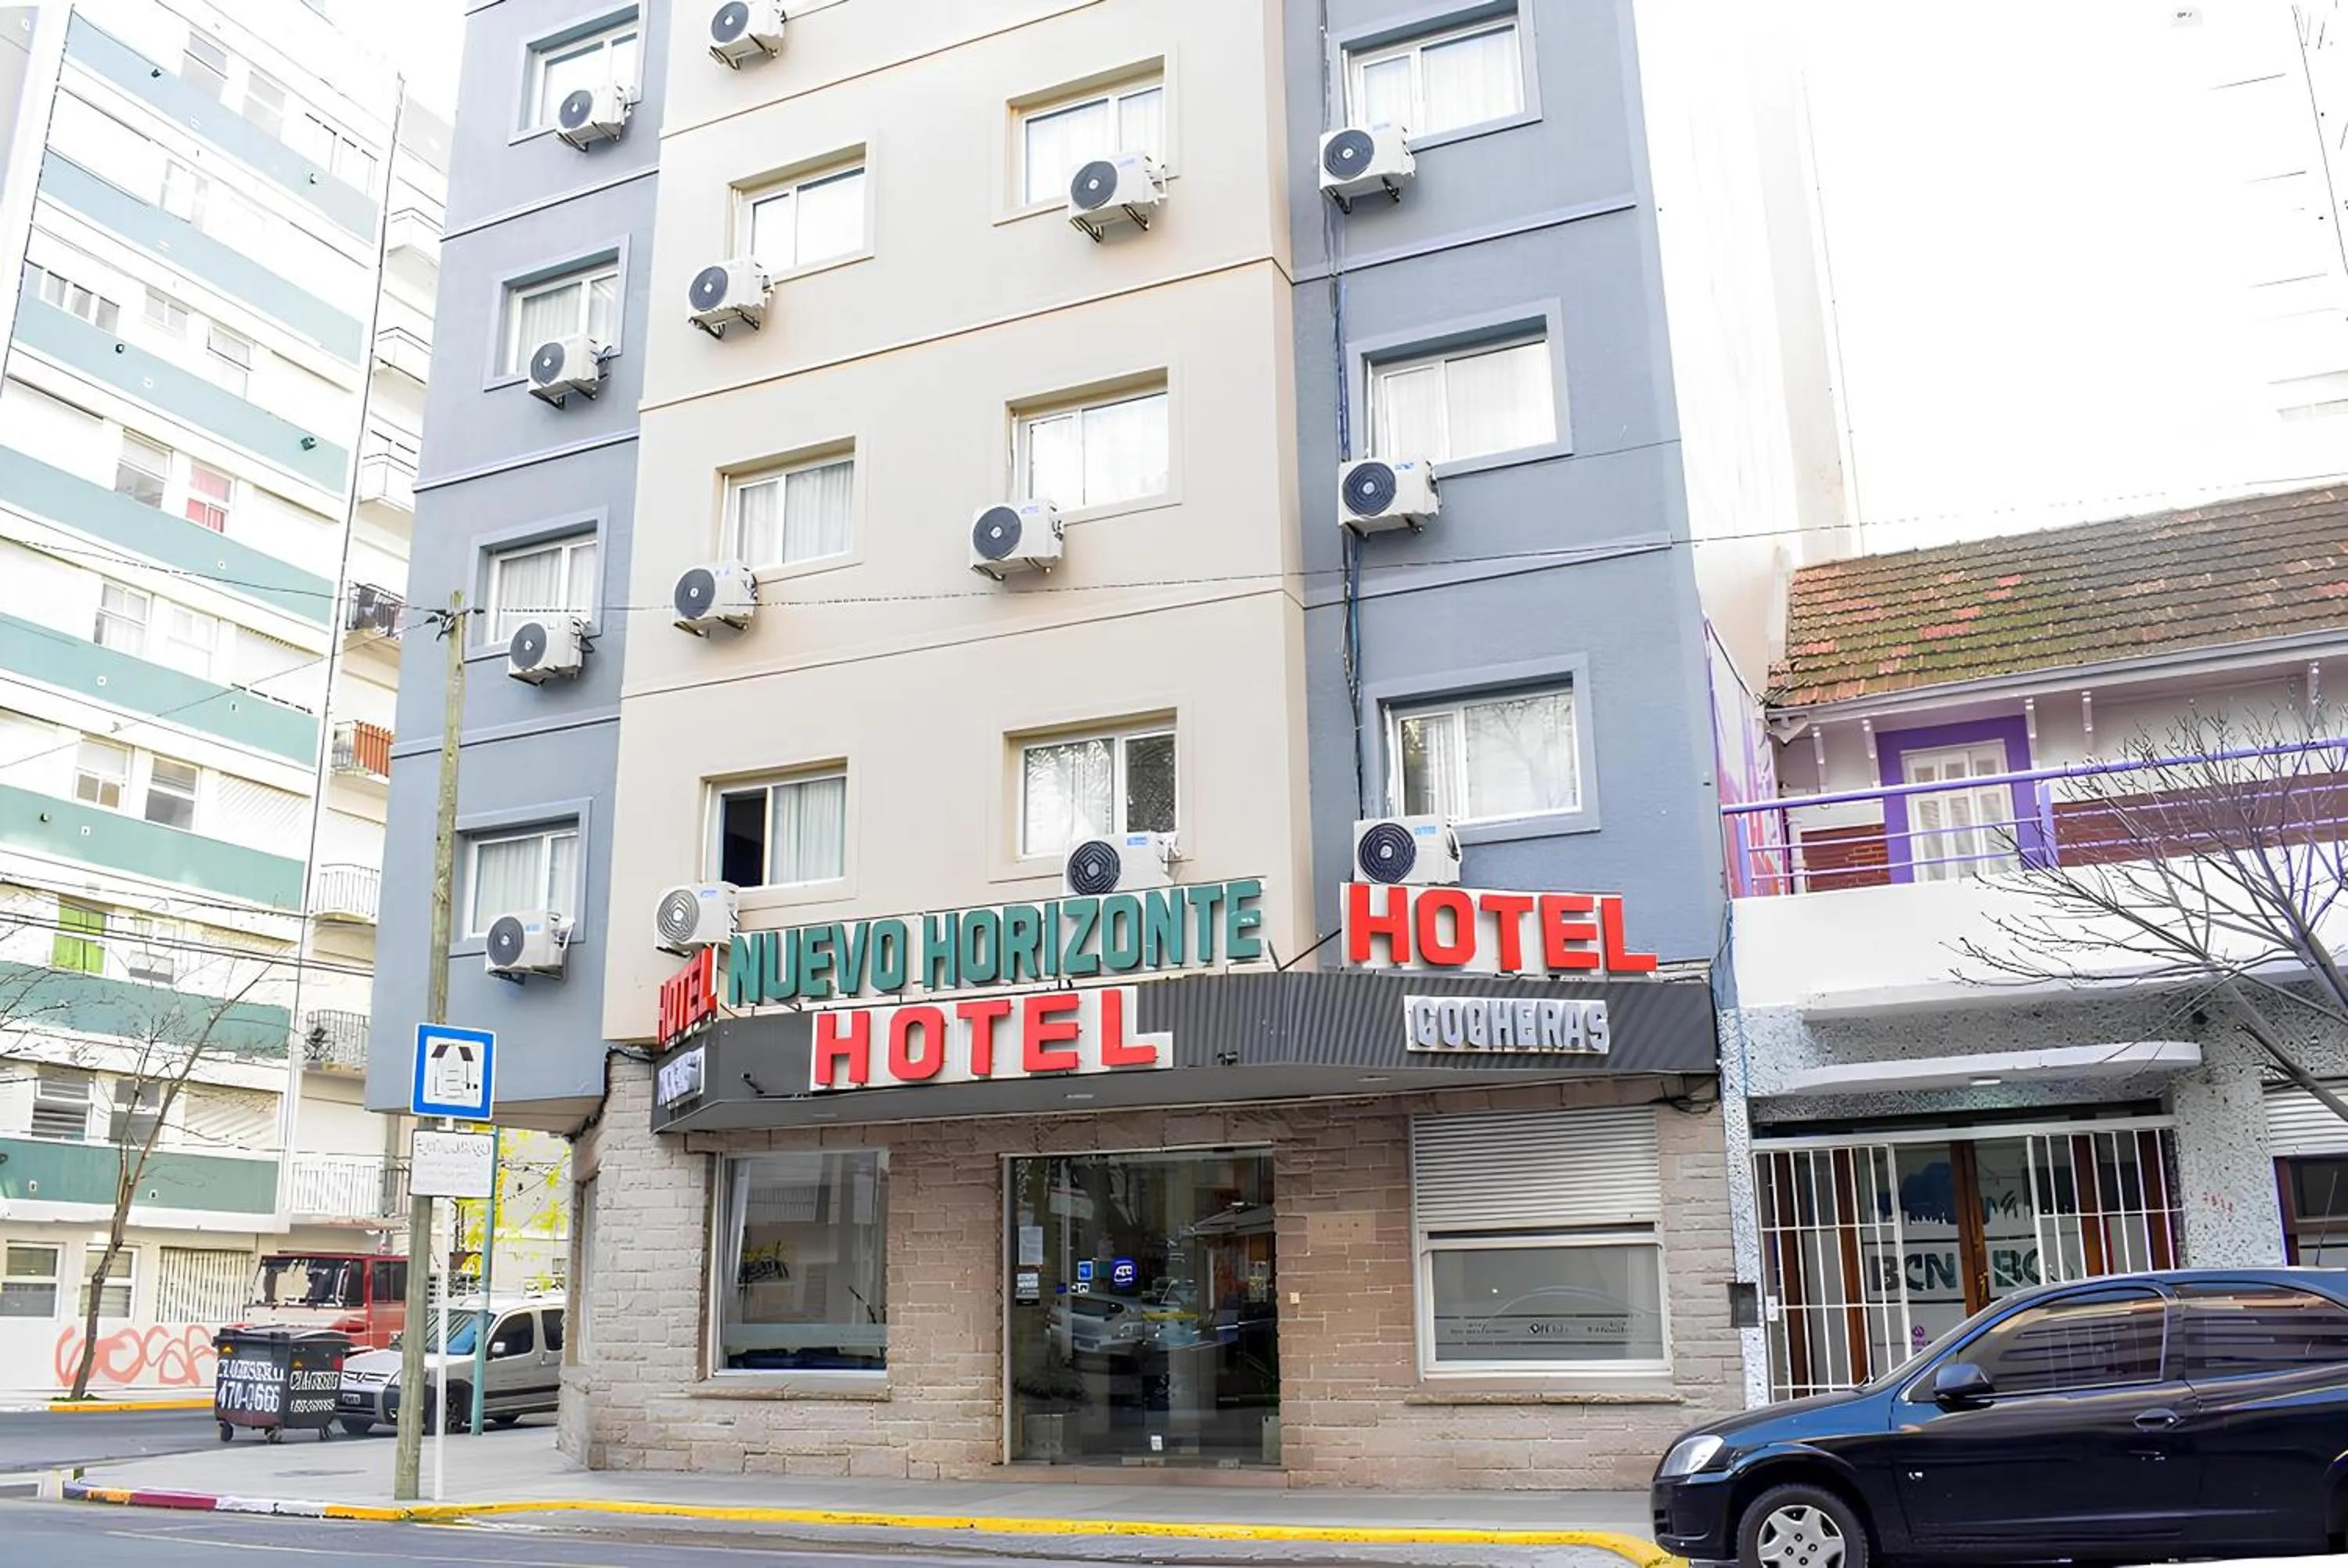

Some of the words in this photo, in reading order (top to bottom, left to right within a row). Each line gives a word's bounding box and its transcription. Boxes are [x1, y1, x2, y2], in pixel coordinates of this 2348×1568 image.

[728, 919, 908, 1005] NUEVO
[924, 881, 1261, 991] HORIZONTE
[1349, 883, 1658, 973] HOTEL
[657, 947, 718, 1047] HOTEL
[816, 989, 1157, 1085] HOTEL
[1871, 1253, 1957, 1292] BCN
